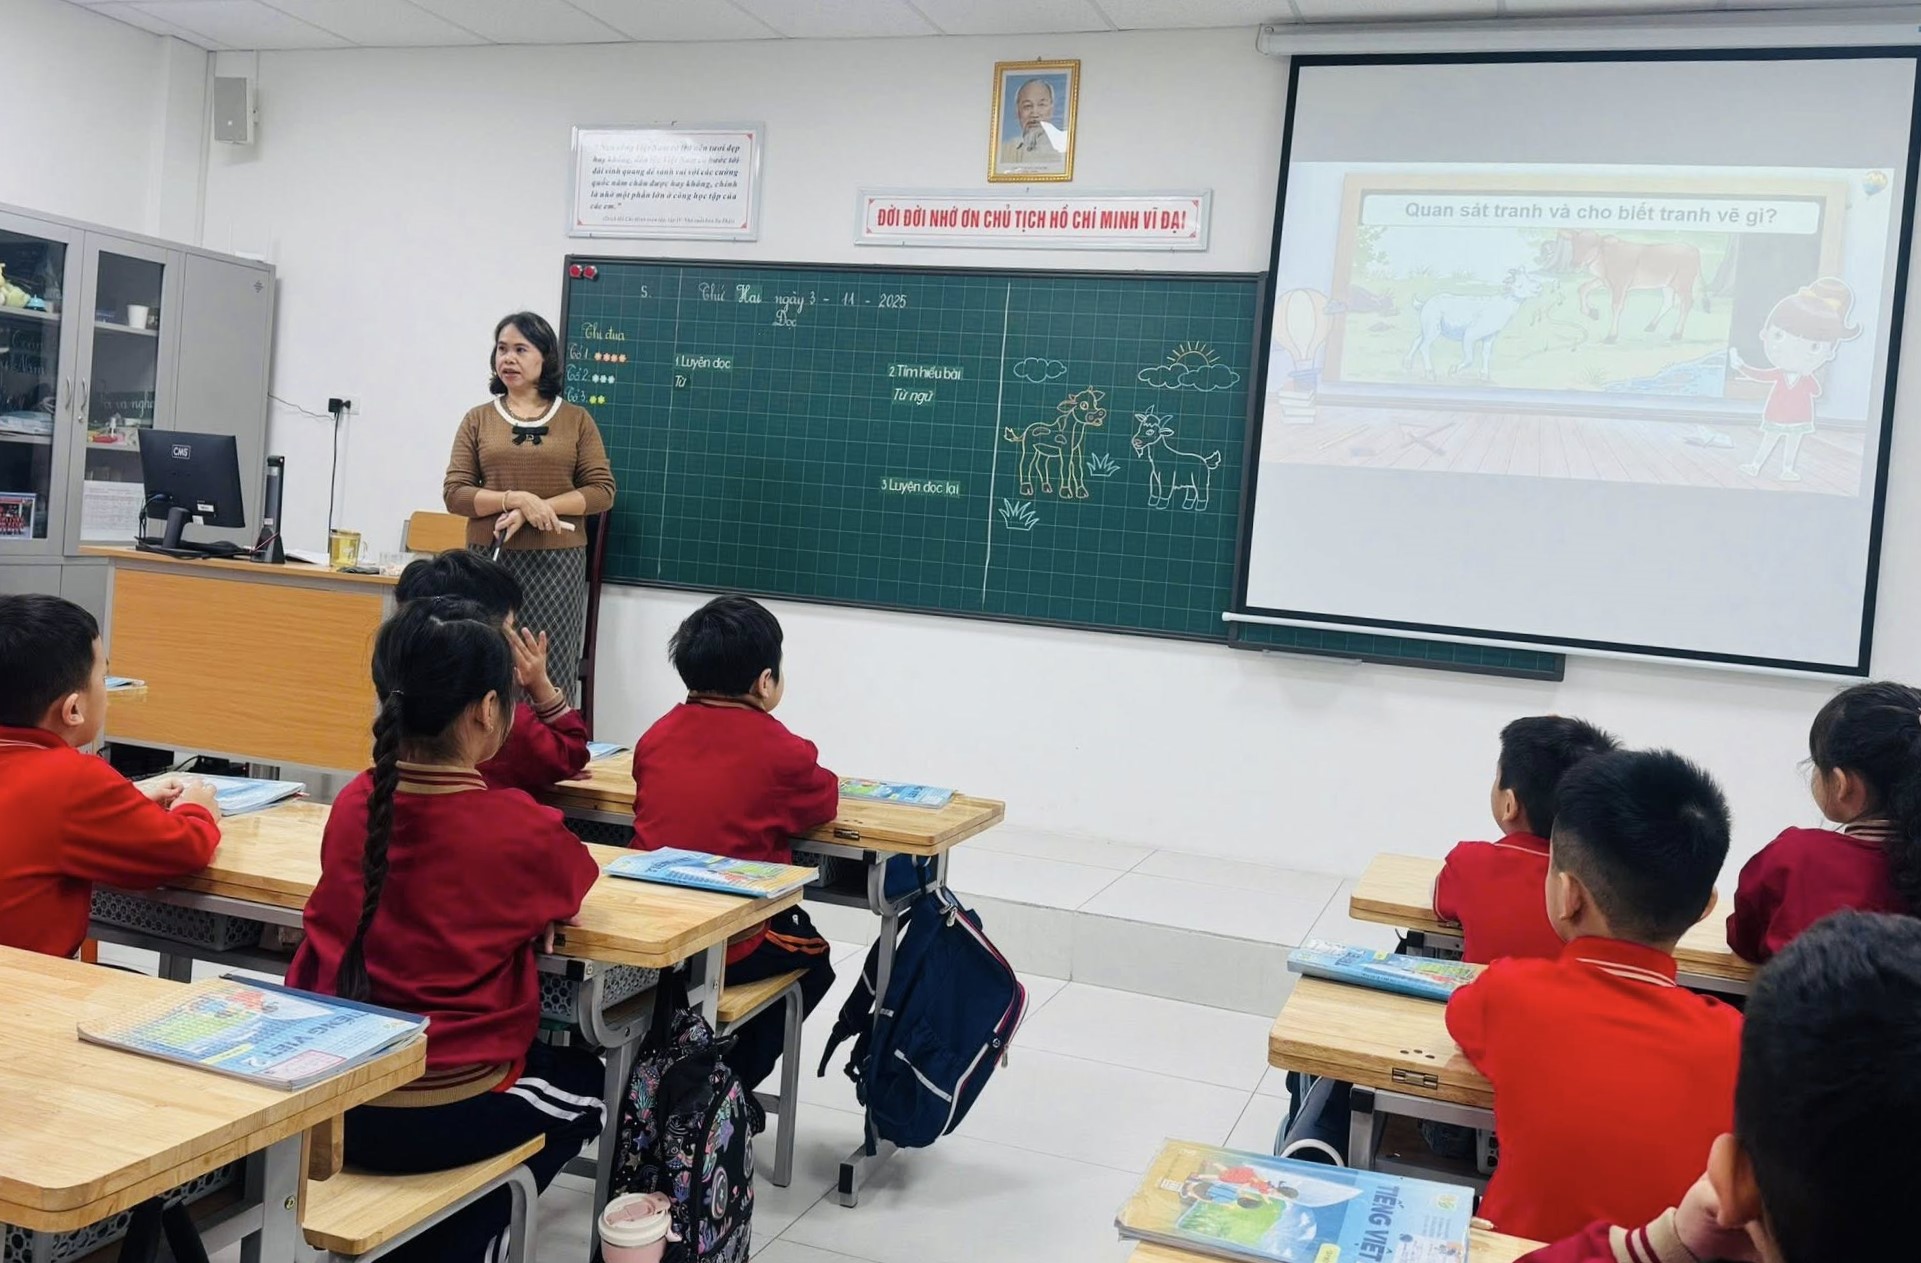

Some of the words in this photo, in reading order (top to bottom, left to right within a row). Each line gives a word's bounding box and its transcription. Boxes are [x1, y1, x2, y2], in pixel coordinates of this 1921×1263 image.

[877, 203, 900, 227] ĐỜI
[903, 203, 926, 227] ĐỜI
[930, 204, 959, 229] NHỚ
[960, 207, 981, 229] ƠN
[984, 203, 1013, 229] CHỦ
[1014, 209, 1046, 233] TỊCH
[1049, 203, 1069, 230] HỒ
[1072, 205, 1098, 231] CHÍ
[1100, 209, 1140, 231] MINH
[1143, 206, 1159, 231] VĨ
[1160, 209, 1188, 235] ĐẠI
[1405, 202, 1454, 219] Quan
[1460, 201, 1489, 218] sát
[1493, 203, 1542, 219] tranh
[1549, 203, 1572, 220] và
[1576, 203, 1613, 221] cho
[1618, 200, 1655, 222] biết
[1659, 205, 1711, 222] tranh
[1717, 207, 1740, 223] vẽ
[1745, 207, 1778, 227] gì?
[698, 281, 725, 301] Thứ
[736, 283, 762, 304] Hai
[774, 290, 804, 314] ngày
[809, 290, 816, 305] 3
[842, 292, 855, 306] 11
[878, 293, 907, 309] 2025
[772, 309, 797, 330] Đọc
[581, 321, 602, 340] Thi
[605, 326, 625, 341] đua
[681, 354, 711, 370] Luyện
[888, 366, 895, 377] 2
[897, 364, 918, 378] Tìm
[675, 374, 687, 388] Từ
[894, 388, 908, 401] Từ
[173, 446, 188, 457] CMS
[881, 479, 887, 490] 3
[889, 478, 921, 495] Luyện
[945, 481, 959, 495] lại
[1368, 1184, 1406, 1228] TIẾNG
[1353, 1229, 1394, 1263] VIỆT
